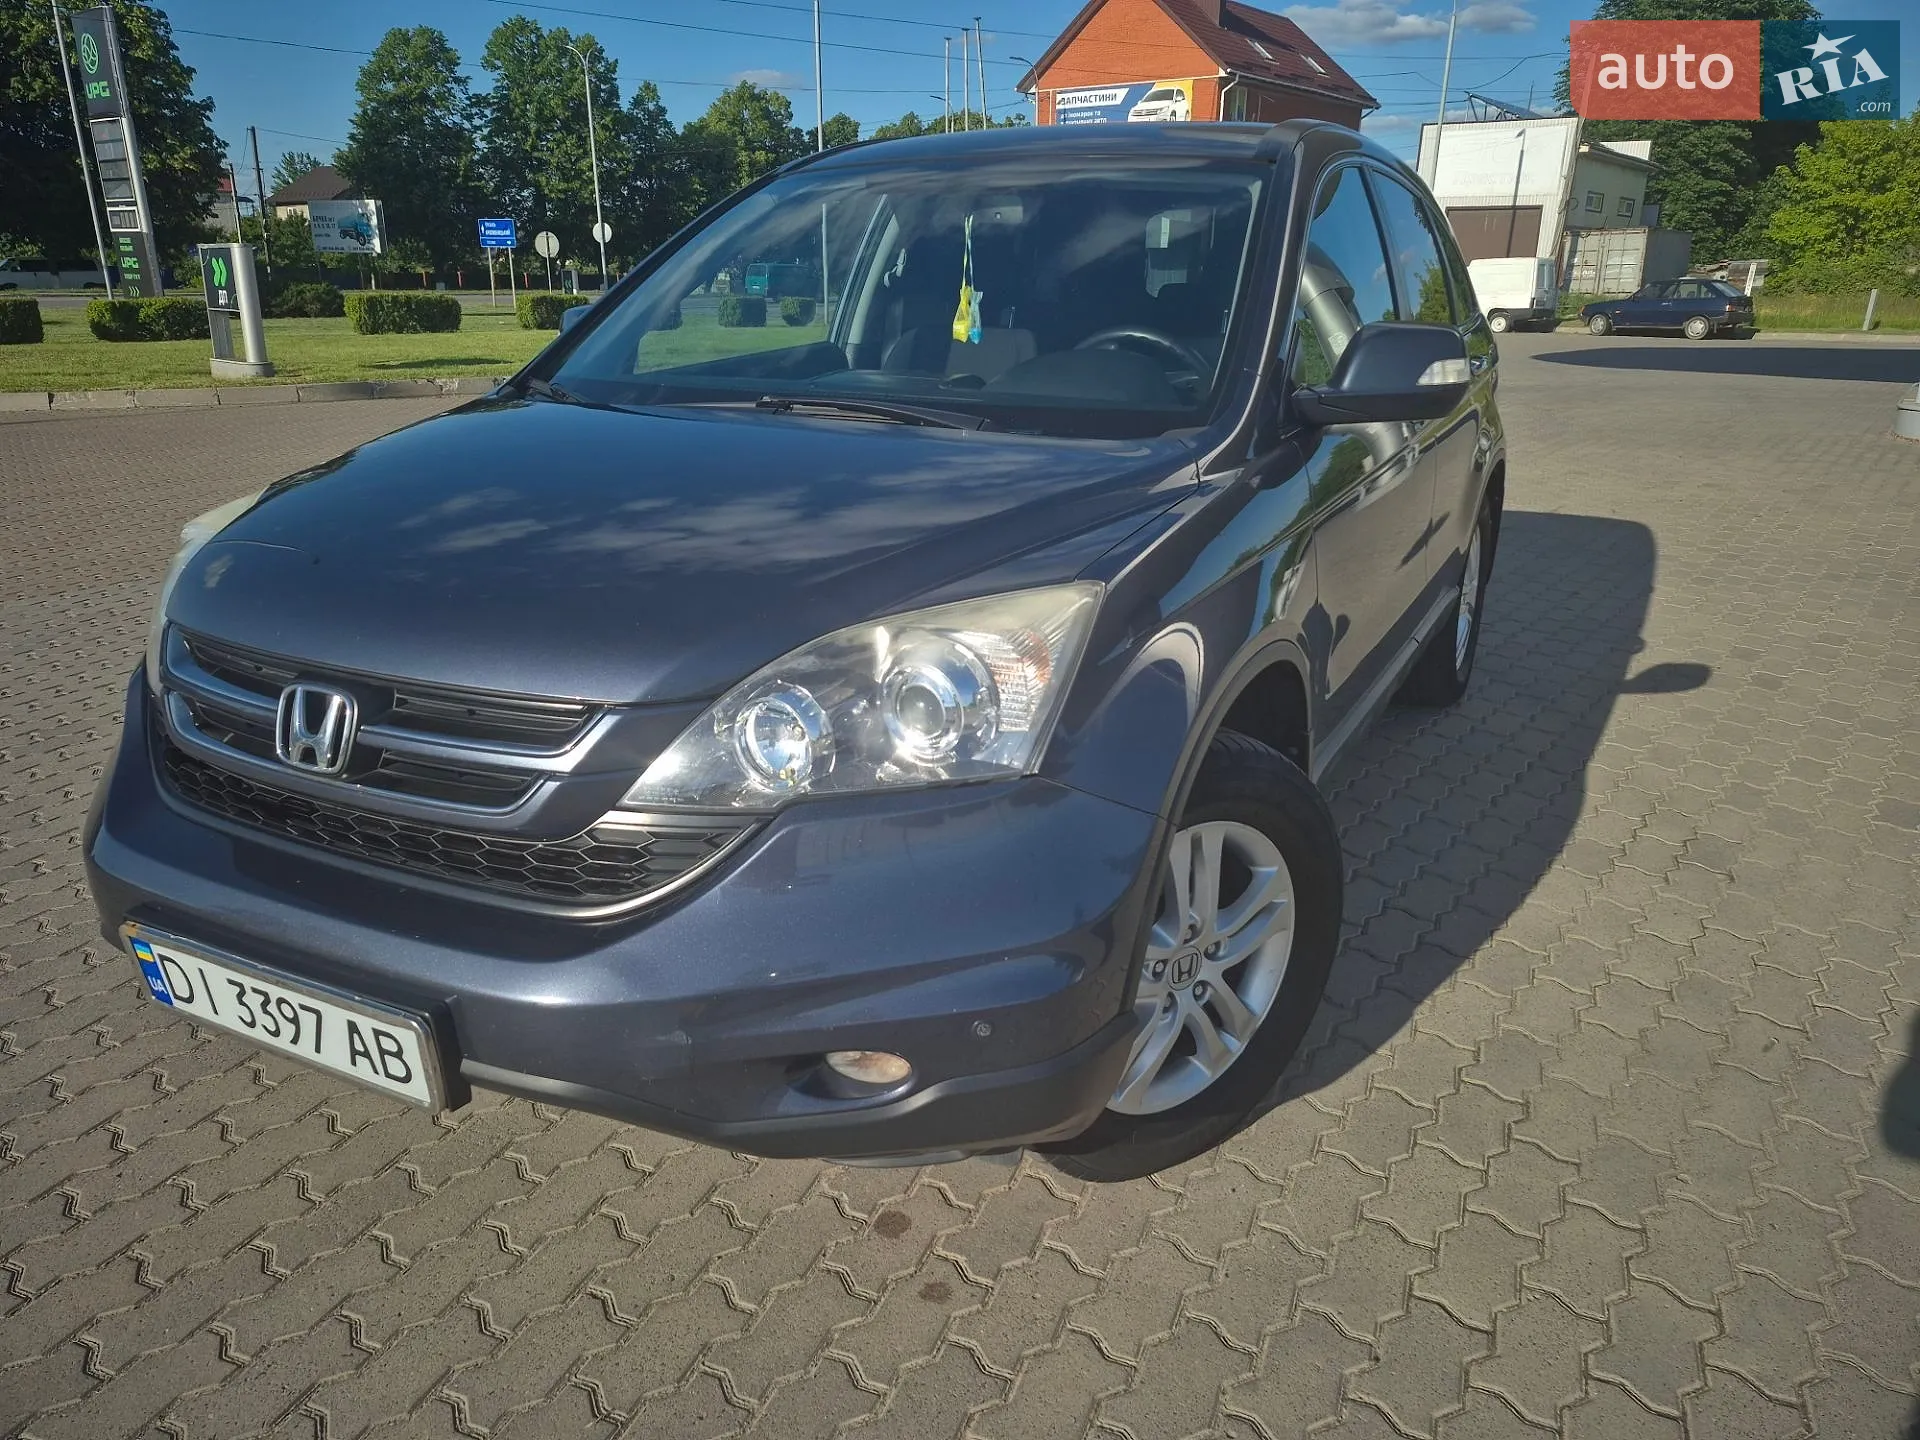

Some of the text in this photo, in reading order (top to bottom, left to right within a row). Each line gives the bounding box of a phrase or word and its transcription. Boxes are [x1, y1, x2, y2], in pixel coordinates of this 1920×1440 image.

[86, 81, 111, 99] UPG
[1061, 93, 1117, 105] ЗАПЧАСТИНИ
[121, 256, 139, 269] UPG
[148, 975, 166, 994] UA
[156, 953, 413, 1085] DI 3397 AB
